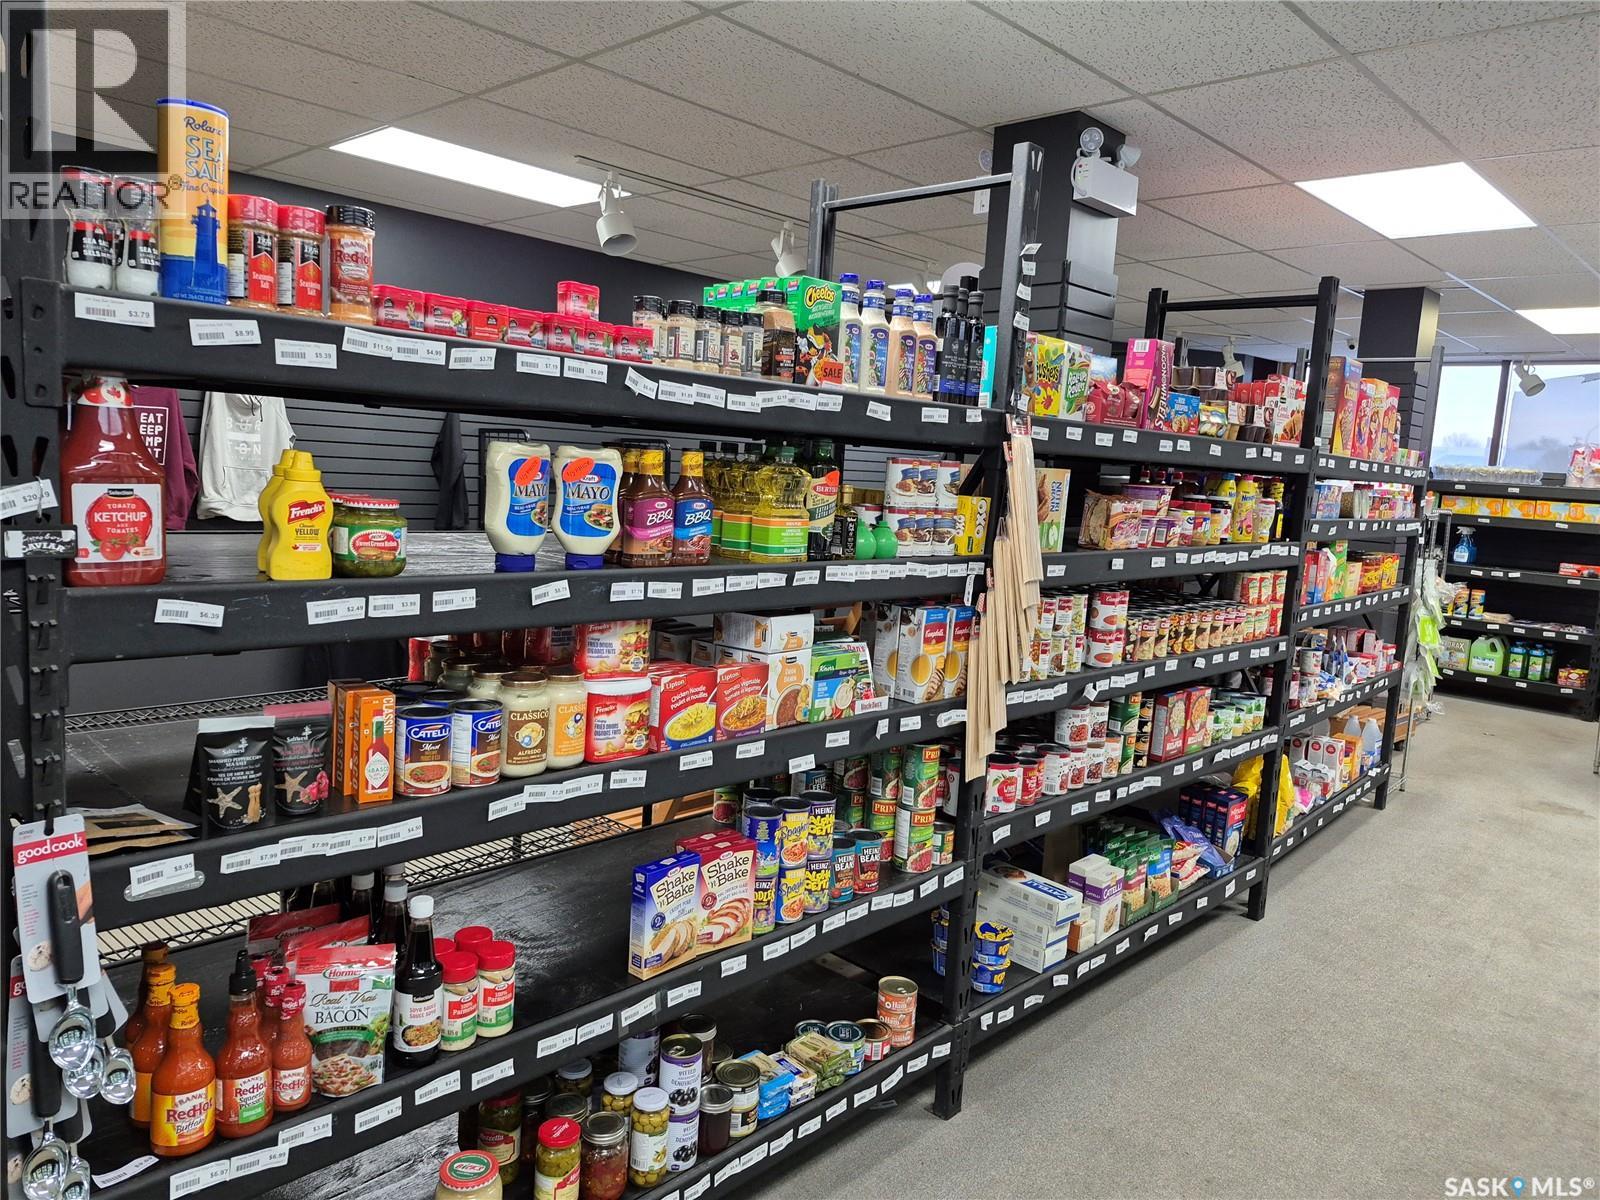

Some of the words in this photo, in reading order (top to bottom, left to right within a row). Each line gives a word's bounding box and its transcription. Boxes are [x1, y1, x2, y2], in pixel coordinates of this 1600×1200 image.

[804, 284, 836, 307] Cheetos
[128, 309, 150, 319] $3.79
[234, 330, 254, 338] $8.99
[823, 367, 842, 378] SALE
[1036, 362, 1059, 382] ushers
[1154, 384, 1167, 431] WHEELS
[140, 413, 163, 424] EAT
[139, 425, 163, 435] EEP
[566, 482, 611, 500] MAYO
[94, 512, 148, 522] KETCHUP
[290, 504, 323, 519] French's
[646, 508, 674, 526] BBQ
[684, 509, 712, 526] BBQ
[974, 498, 988, 539] OXO
[295, 528, 320, 536] YELLOW
[199, 611, 220, 620] $6.39
[721, 672, 740, 682] Lipton
[666, 679, 685, 689] Lipton
[724, 683, 741, 696] Tomato
[741, 678, 761, 688] Vegetable
[671, 690, 690, 703] Chicken
[690, 685, 706, 694] Noodle
[670, 698, 687, 710] Poulet
[690, 692, 708, 701] nouilles
[383, 697, 394, 734] CLASSIC
[410, 727, 449, 739] CATELLI
[352, 705, 360, 789] TABASCO
[419, 743, 441, 752] Meat
[518, 748, 542, 756] ALFREDO
[815, 805, 834, 814] HEINZ
[874, 804, 896, 813] PRIM
[407, 824, 422, 833] $4.50
[359, 834, 376, 842] $7.99
[312, 840, 330, 849] $7.99
[260, 852, 278, 861] $7.99
[174, 863, 194, 872] $8.95
[707, 854, 750, 879] Shake
[810, 862, 830, 871] HEINZ
[716, 867, 749, 888] Bake
[655, 870, 696, 899] Shake
[664, 882, 695, 906] Bake
[1103, 882, 1123, 899] CATELLI
[314, 1007, 371, 1024] BACON
[234, 1080, 268, 1098] RedHot
[165, 1097, 213, 1123] RedHot
[268, 1151, 287, 1161] $6.99
[209, 1169, 229, 1179] $6.97
